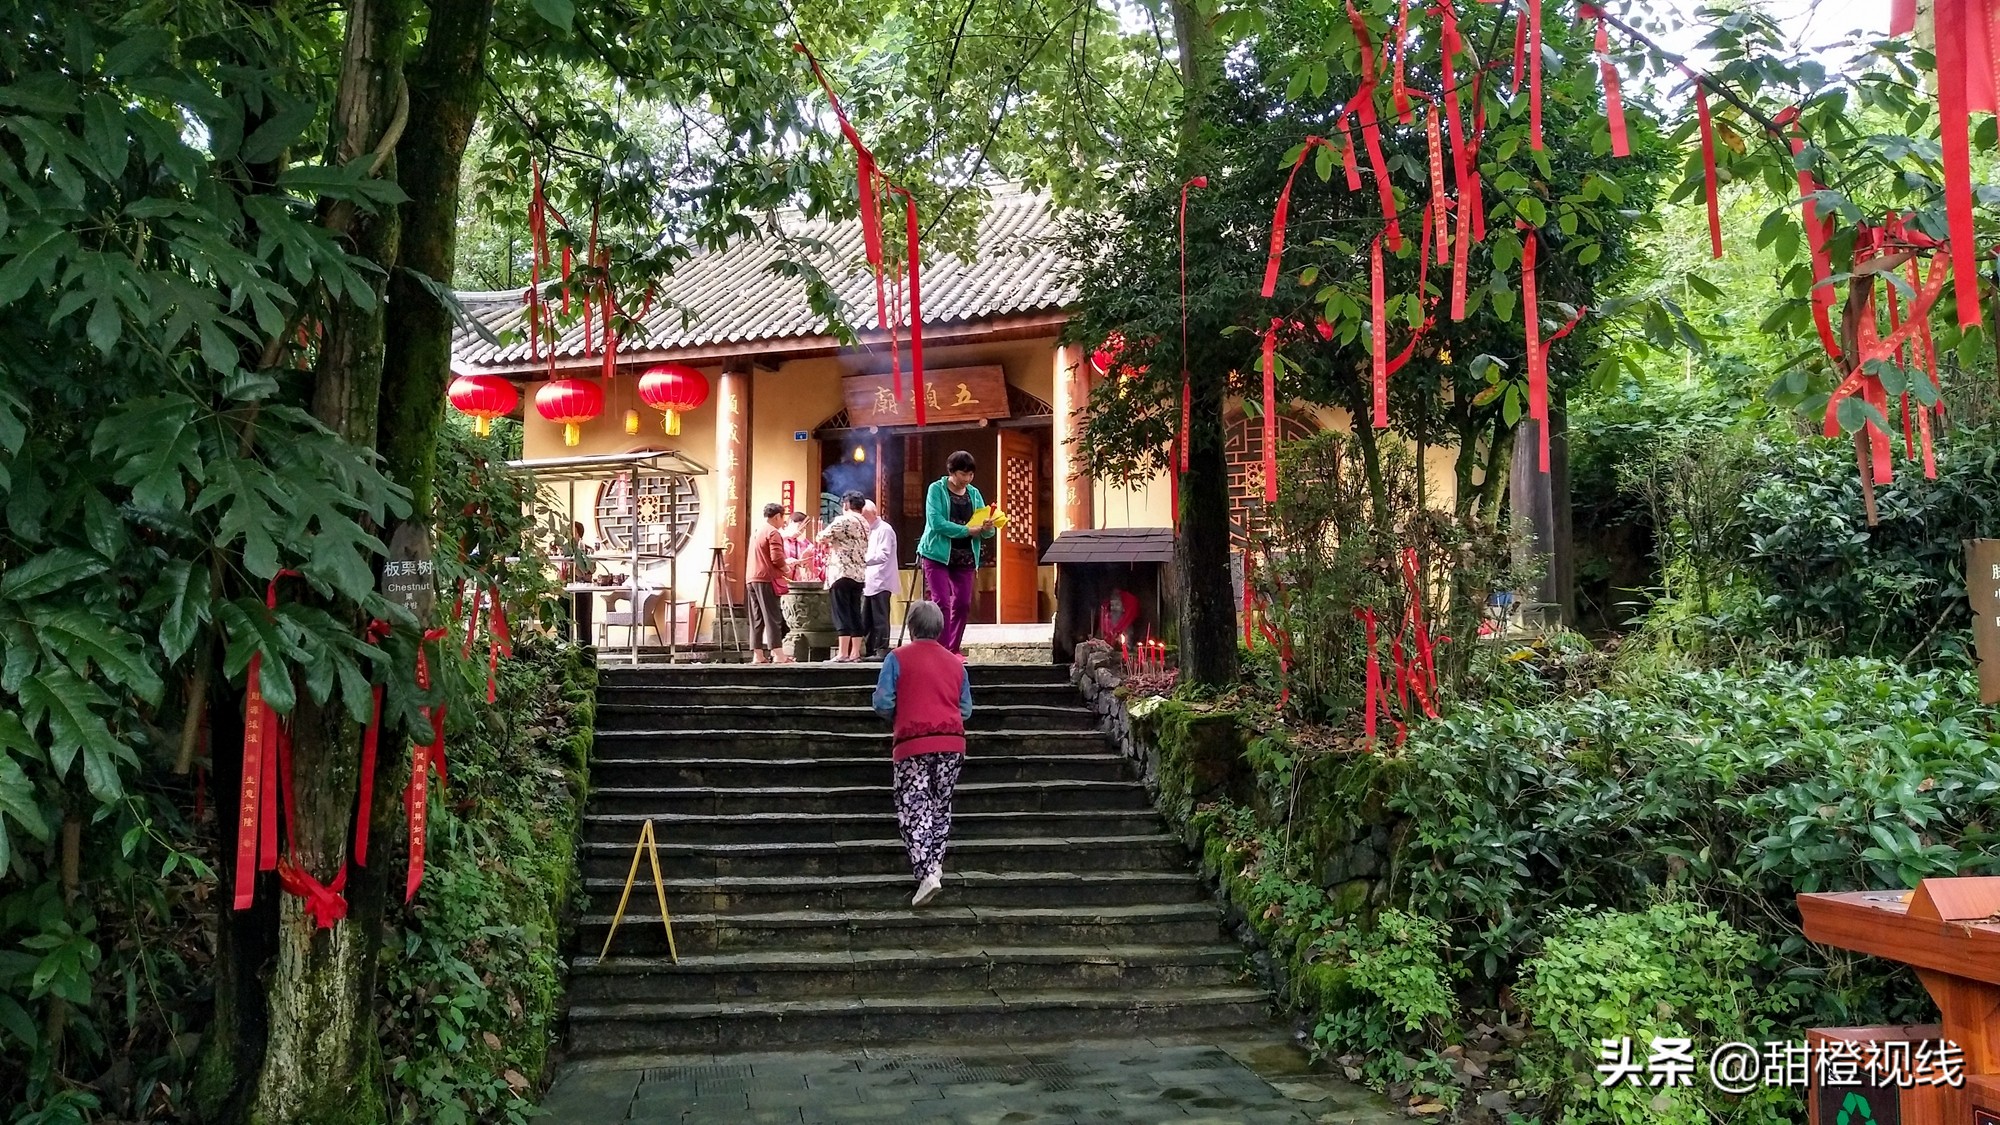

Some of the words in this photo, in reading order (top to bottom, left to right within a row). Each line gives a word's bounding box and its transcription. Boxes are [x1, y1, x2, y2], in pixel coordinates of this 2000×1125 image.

[383, 560, 433, 577] 板栗树
[388, 583, 430, 592] Chestnut
[413, 801, 423, 846] 吉祥如意
